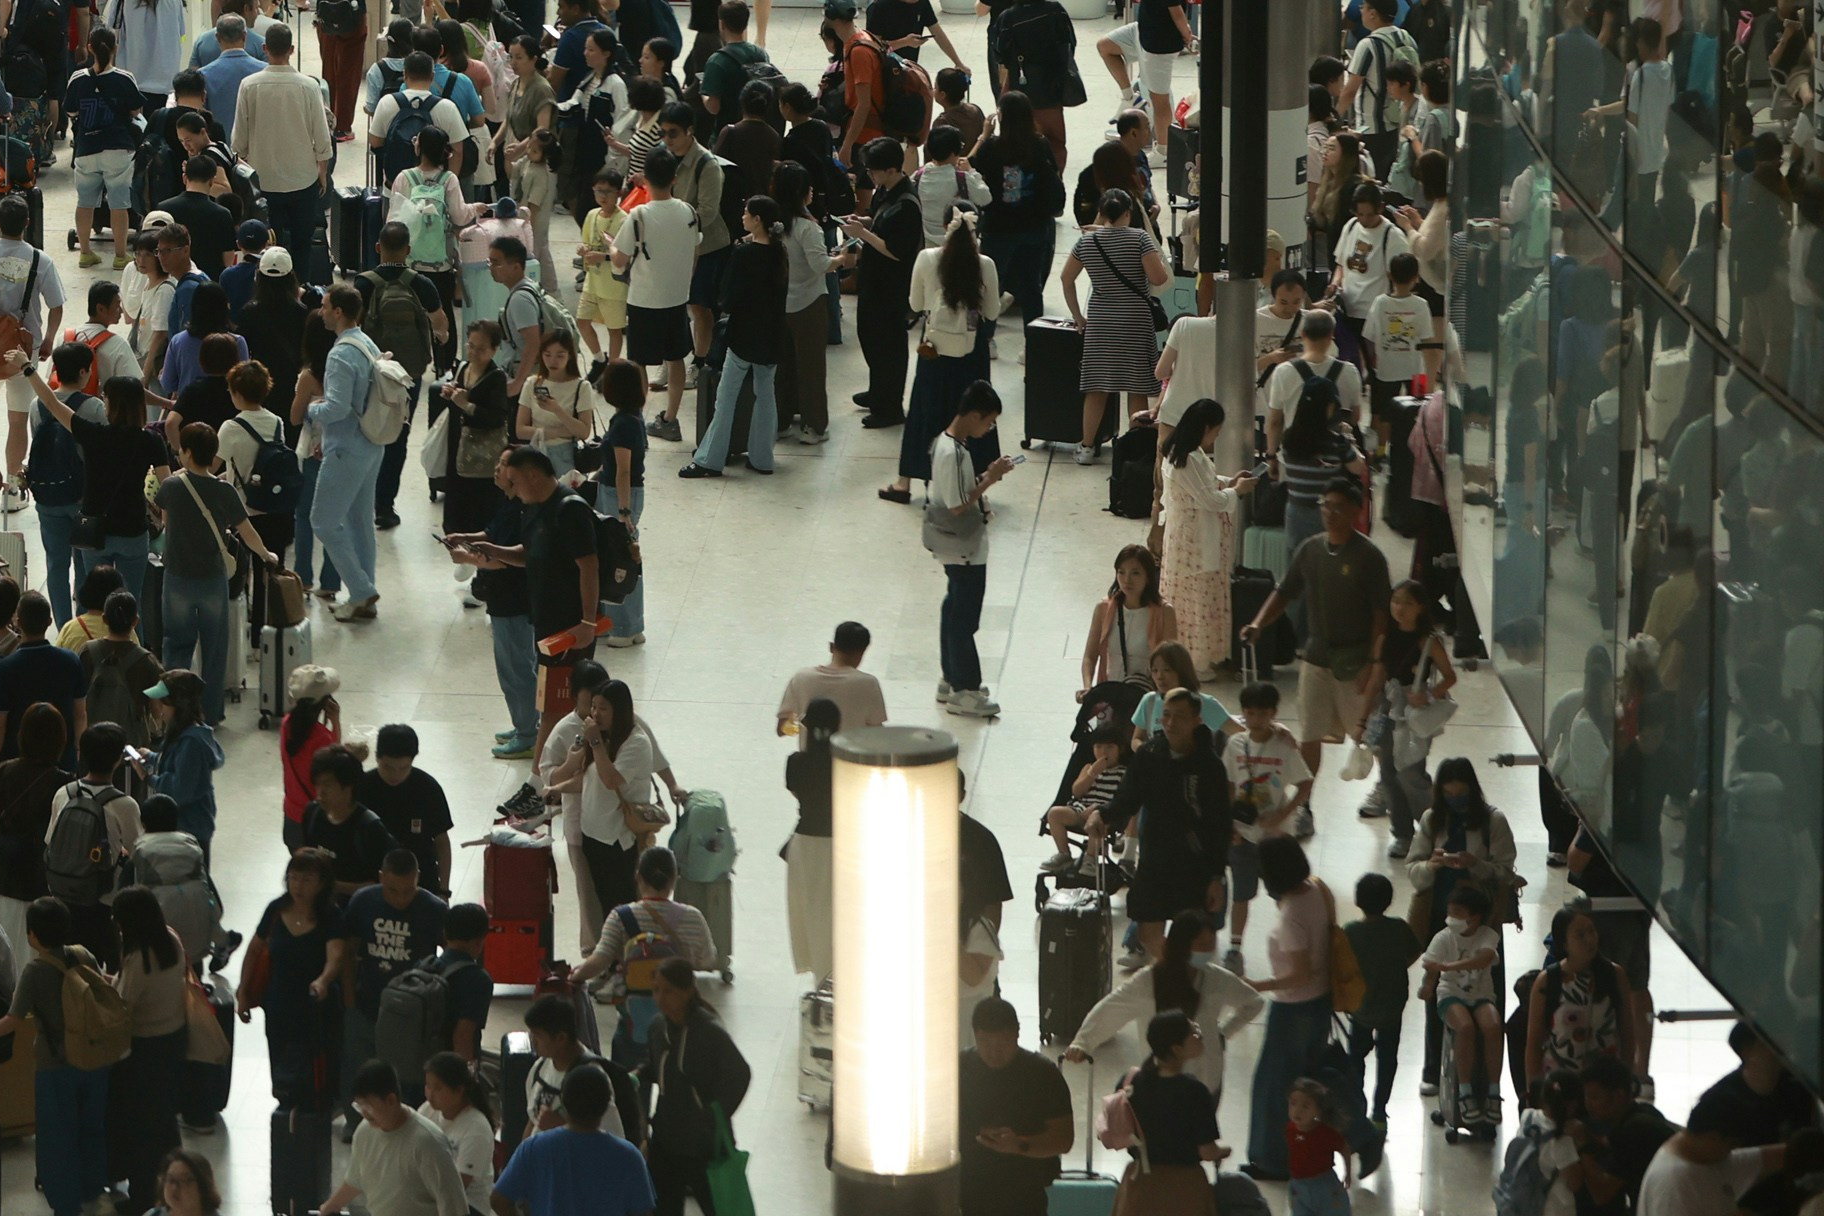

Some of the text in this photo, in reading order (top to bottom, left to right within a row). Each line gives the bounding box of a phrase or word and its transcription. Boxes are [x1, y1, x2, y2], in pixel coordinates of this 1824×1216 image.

[373, 917, 411, 936] CALL
[375, 932, 405, 948] THE
[367, 943, 412, 961] BANK
